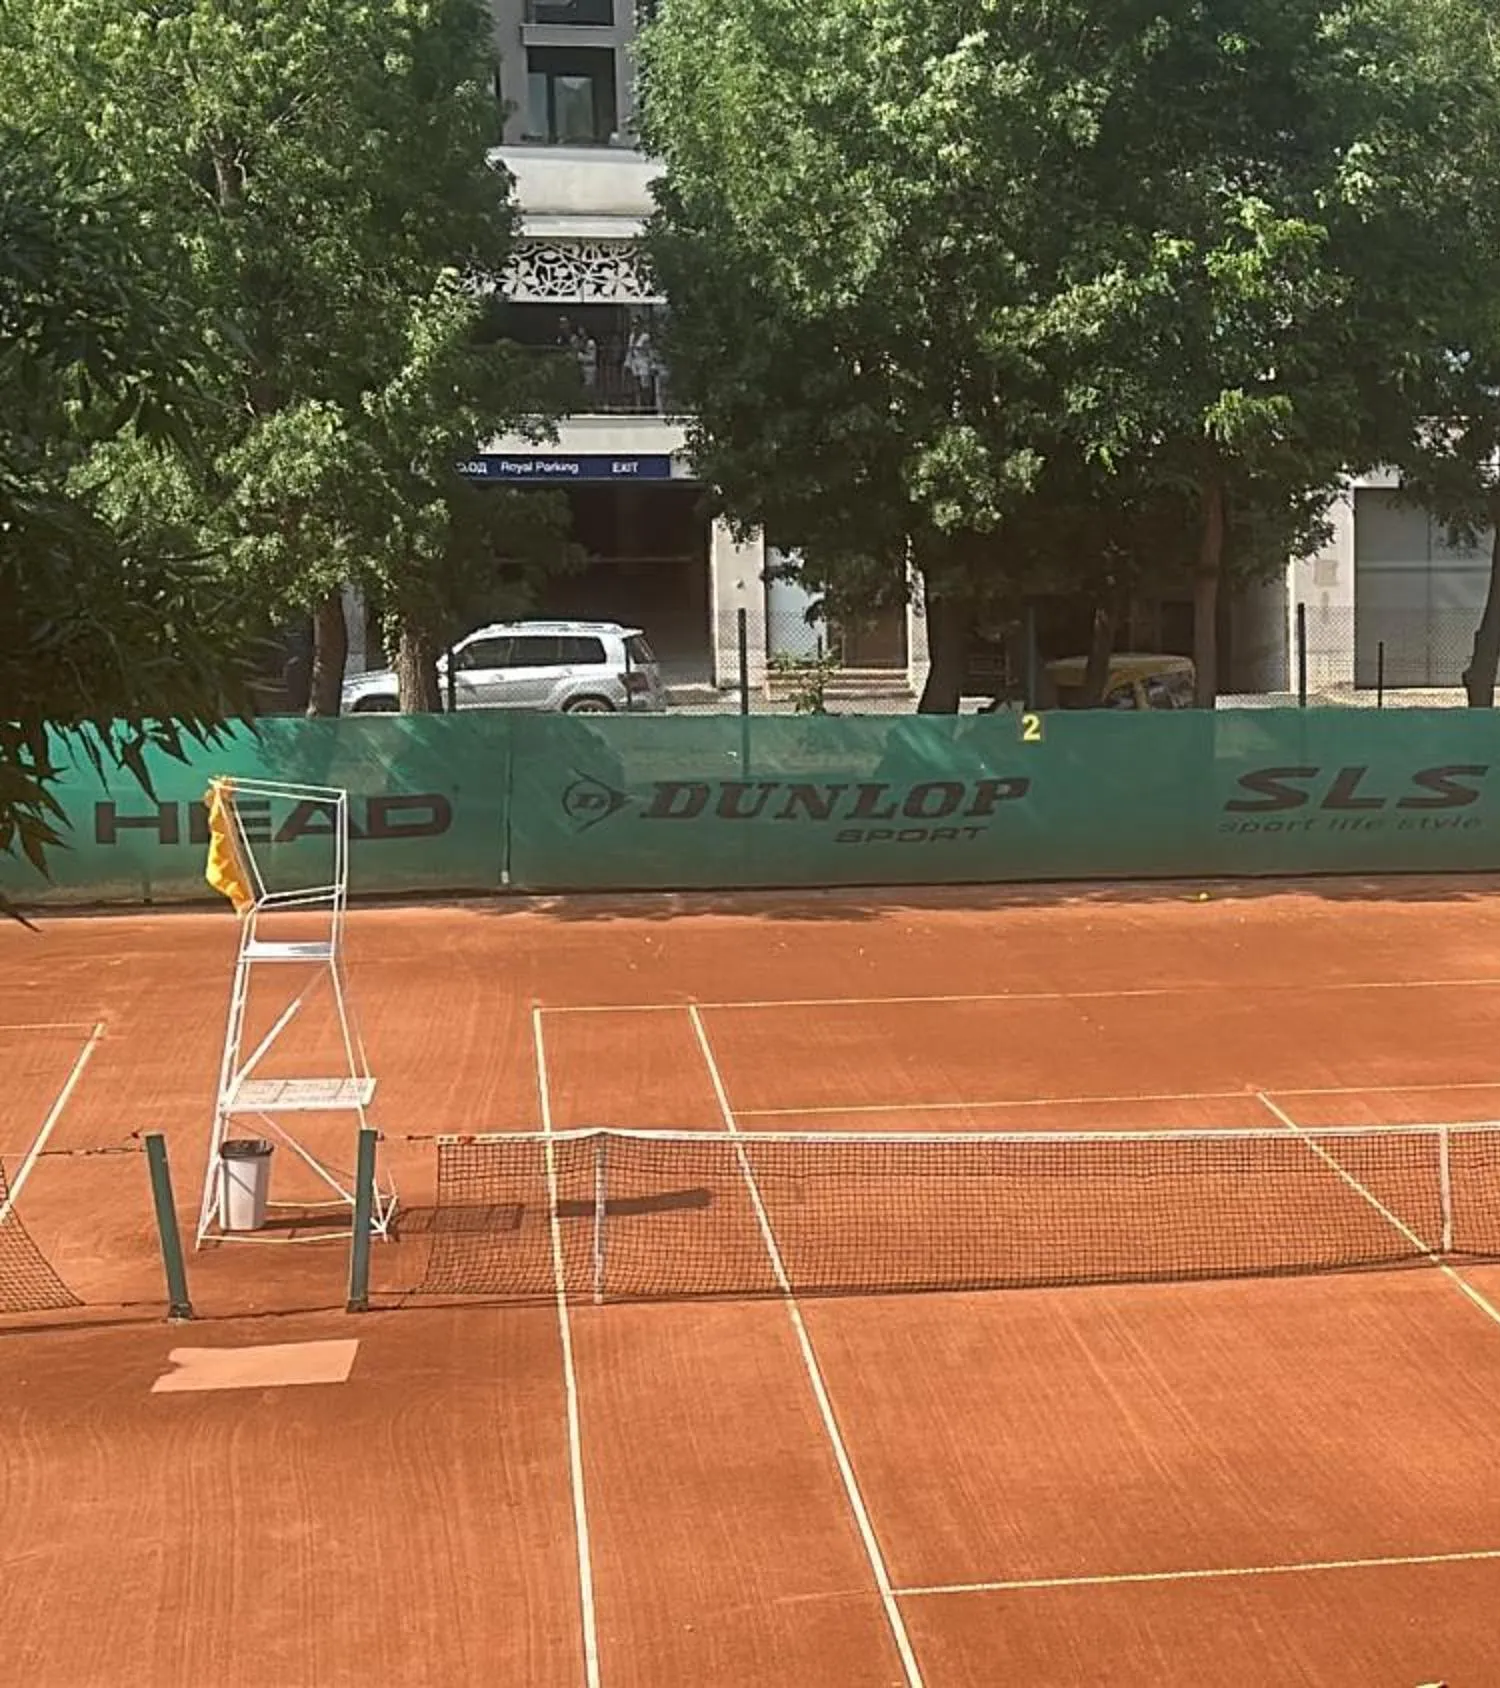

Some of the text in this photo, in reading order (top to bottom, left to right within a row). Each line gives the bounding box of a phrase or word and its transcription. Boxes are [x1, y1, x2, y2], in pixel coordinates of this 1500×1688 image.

[501, 461, 579, 475] Royal Parking
[612, 461, 639, 473] EXIT
[1022, 713, 1041, 741] 2
[1223, 764, 1490, 812] SLS
[640, 778, 1030, 820] DUNLOP
[833, 826, 990, 843] SPORT
[1217, 814, 1484, 835] sport life style
